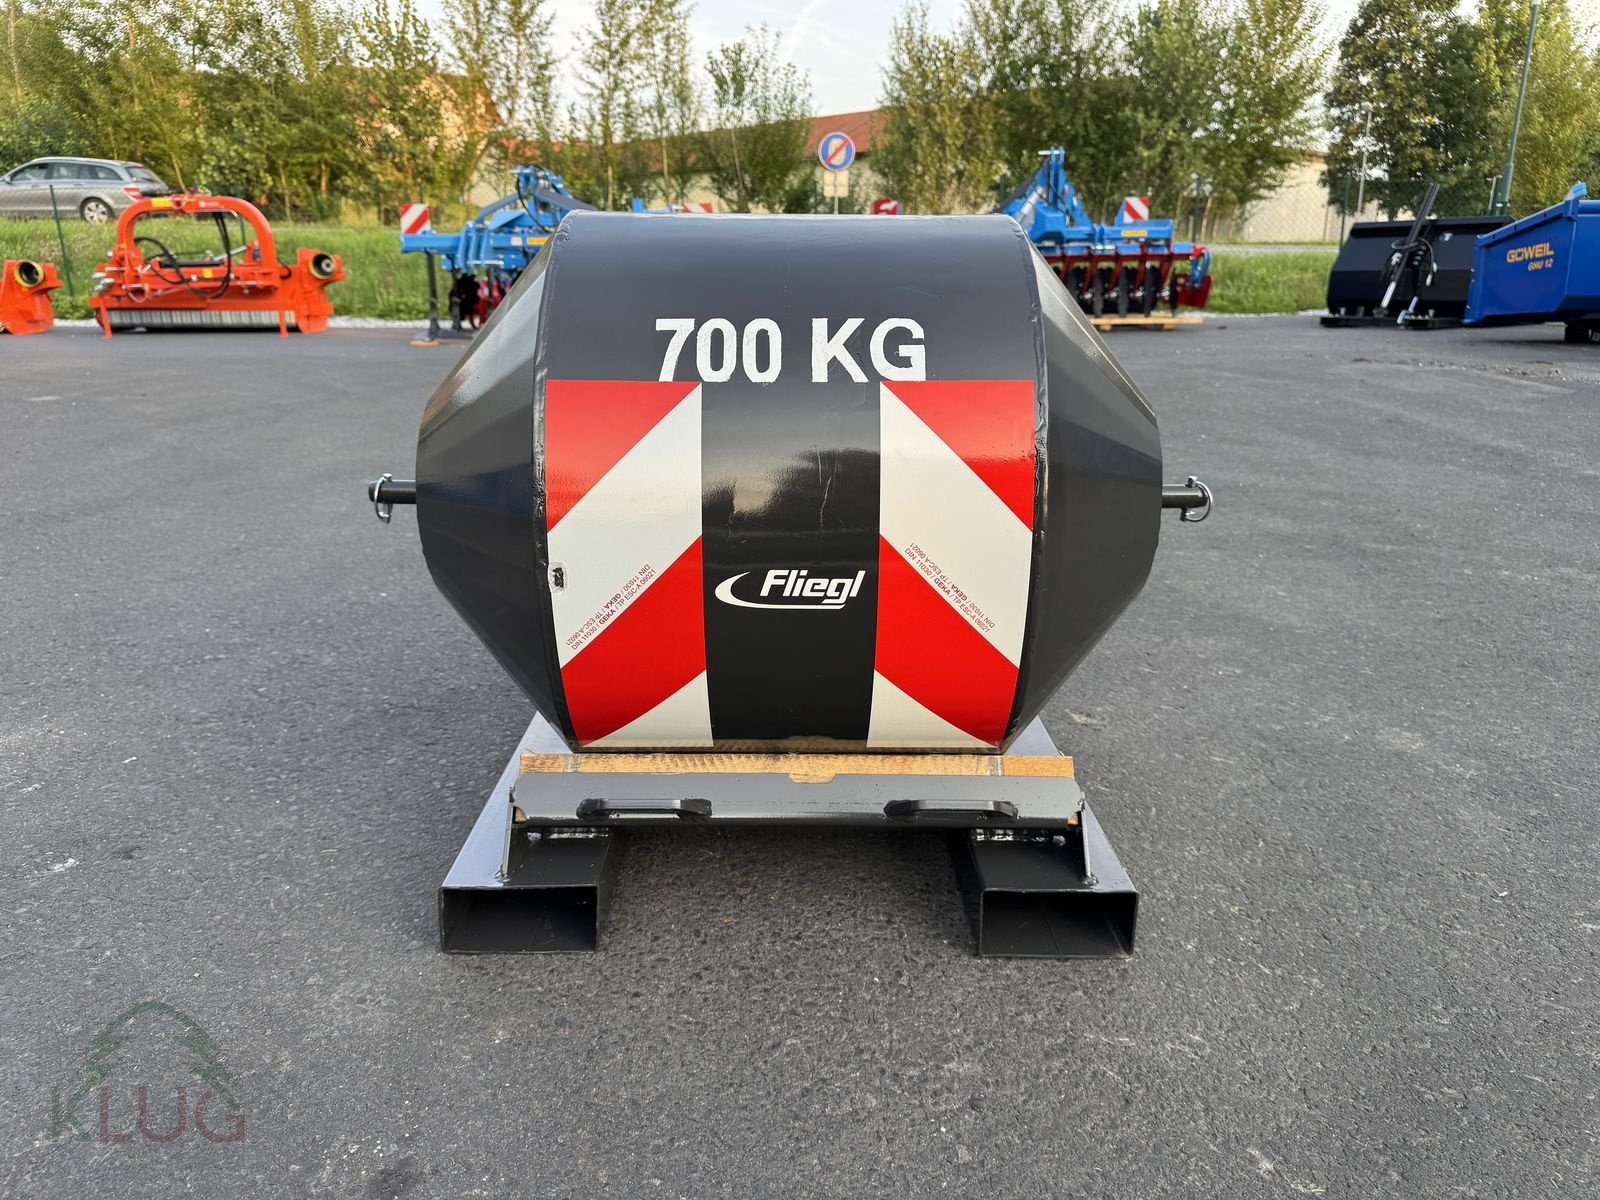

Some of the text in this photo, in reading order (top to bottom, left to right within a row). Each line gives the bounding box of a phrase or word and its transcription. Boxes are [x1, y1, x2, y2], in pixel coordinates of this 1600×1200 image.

[1545, 258, 1554, 268] 12
[655, 317, 926, 383] 700 KG
[638, 563, 651, 576] DIN
[904, 547, 917, 561] DIN
[915, 559, 933, 576] 11030
[933, 577, 951, 596] GEKA
[952, 596, 962, 604] TP
[623, 576, 640, 592] 11030
[759, 569, 866, 604] Fliegl
[939, 575, 949, 583] TP
[950, 583, 968, 601] GEKA
[603, 593, 622, 609] GEKA
[594, 611, 603, 620] TP
[969, 602, 985, 619] 11030
[571, 640, 583, 650] DIN
[581, 626, 598, 641] 11030
[598, 609, 617, 625] GEKA
[617, 598, 625, 607] TP
[983, 617, 996, 629] DIN
